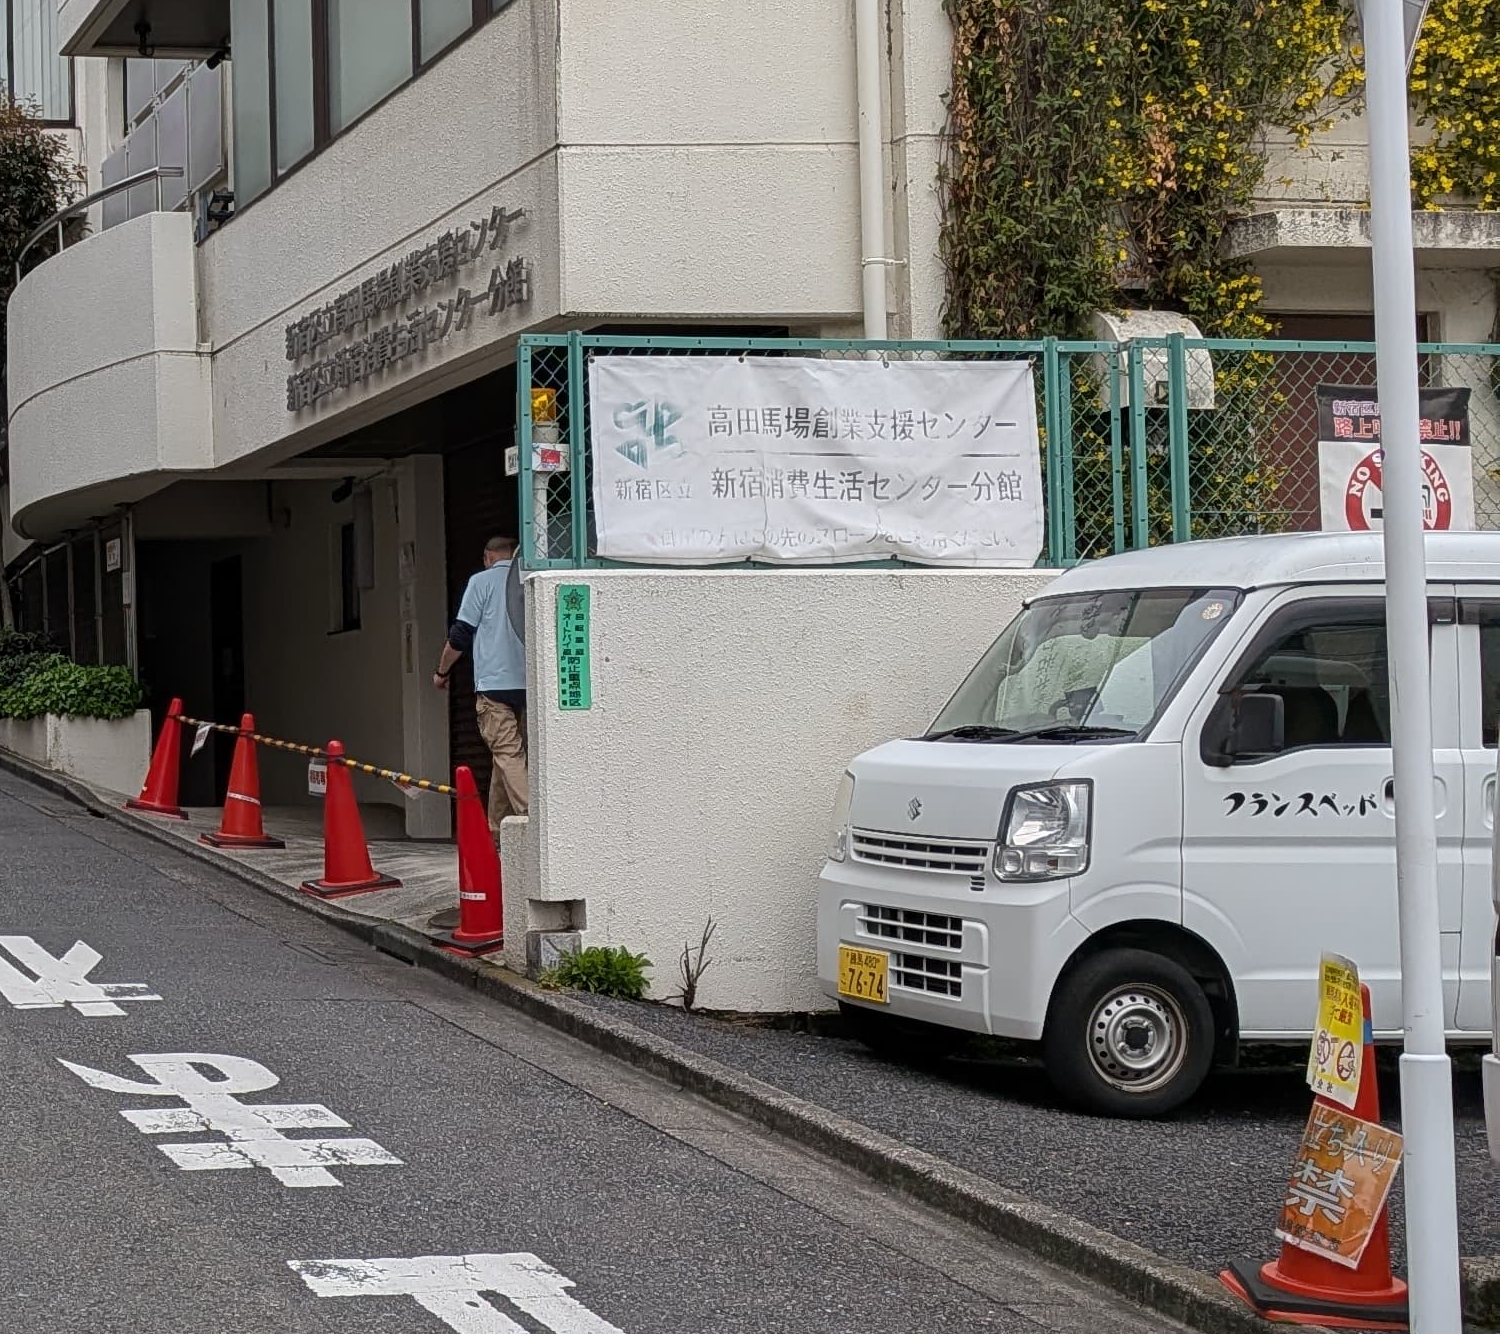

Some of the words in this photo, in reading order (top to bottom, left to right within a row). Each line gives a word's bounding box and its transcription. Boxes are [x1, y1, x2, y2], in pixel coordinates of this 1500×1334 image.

[707, 404, 1017, 441] 高田馬場創業支援センター
[615, 478, 693, 500] 新宿区立
[711, 467, 1023, 502] 新宿消費生活センター分館
[1349, 466, 1370, 498] NO
[1222, 792, 1378, 817] フランスベッド
